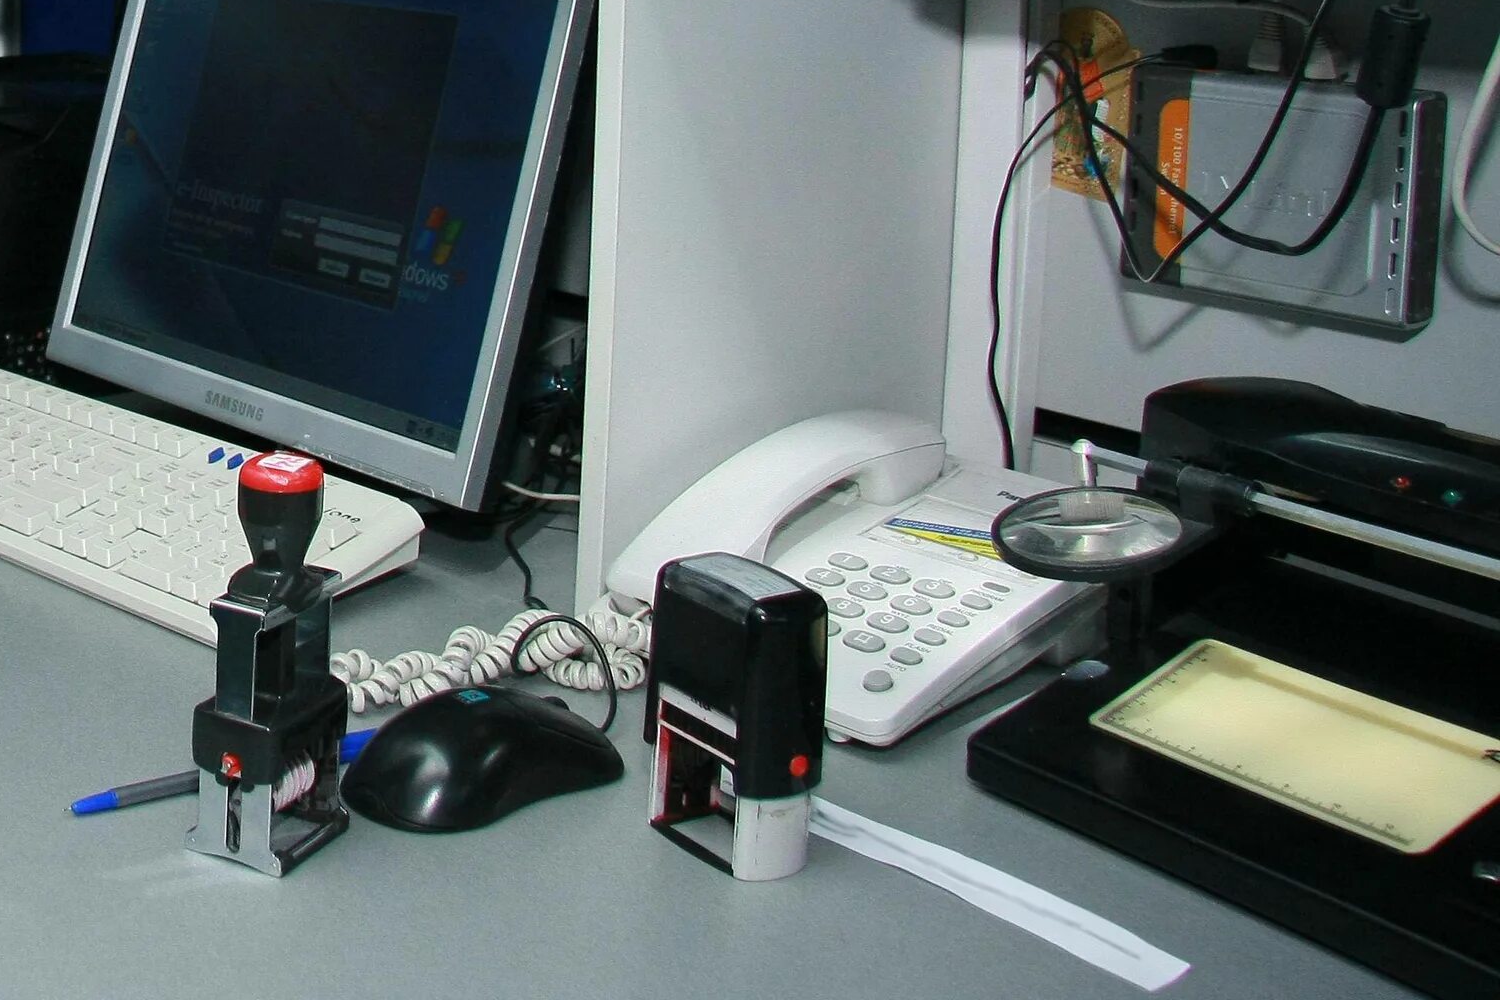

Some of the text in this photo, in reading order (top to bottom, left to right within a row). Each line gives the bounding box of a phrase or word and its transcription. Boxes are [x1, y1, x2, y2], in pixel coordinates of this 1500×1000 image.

[1172, 127, 1183, 164] 10/100
[403, 260, 449, 291] dows
[204, 389, 265, 422] SAMSUNG
[951, 606, 978, 618] PAUSE
[927, 623, 954, 636] REDIAL
[905, 642, 931, 654] FLASH
[884, 661, 907, 672] AUTO
